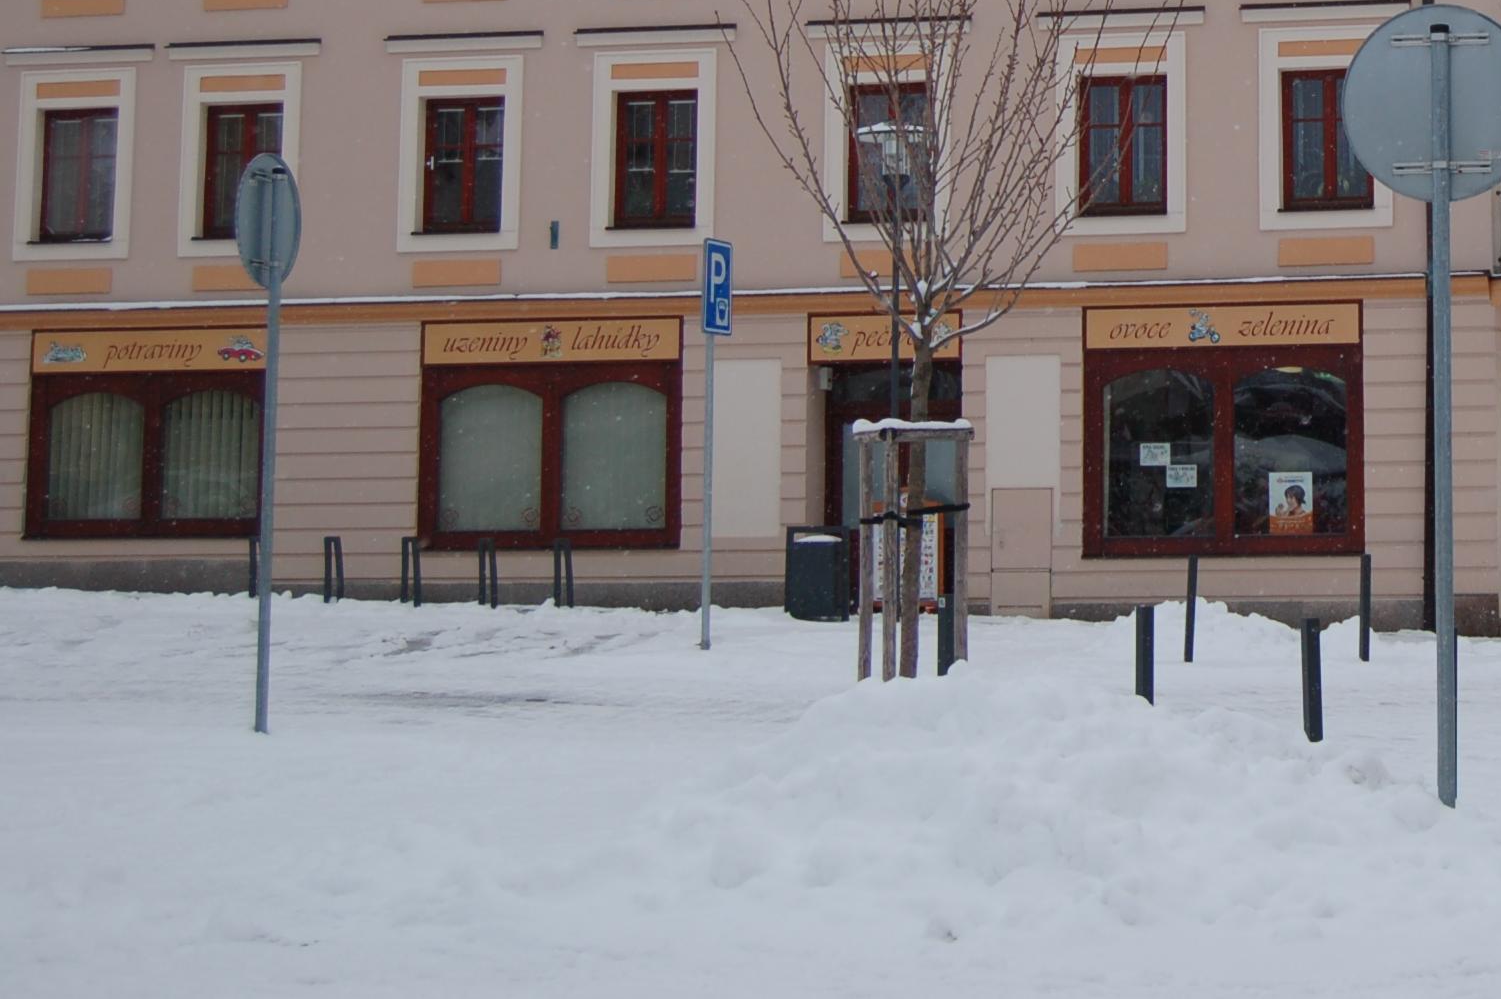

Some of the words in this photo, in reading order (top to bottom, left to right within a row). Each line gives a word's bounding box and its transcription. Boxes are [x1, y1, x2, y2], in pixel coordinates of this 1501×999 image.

[711, 252, 727, 303] P
[442, 331, 529, 361] uzeniny
[571, 324, 661, 358] lahůdky
[850, 323, 915, 357] peč
[1108, 320, 1173, 341] ovoce
[1237, 311, 1336, 338] zelenina
[102, 338, 203, 368] potraviny
